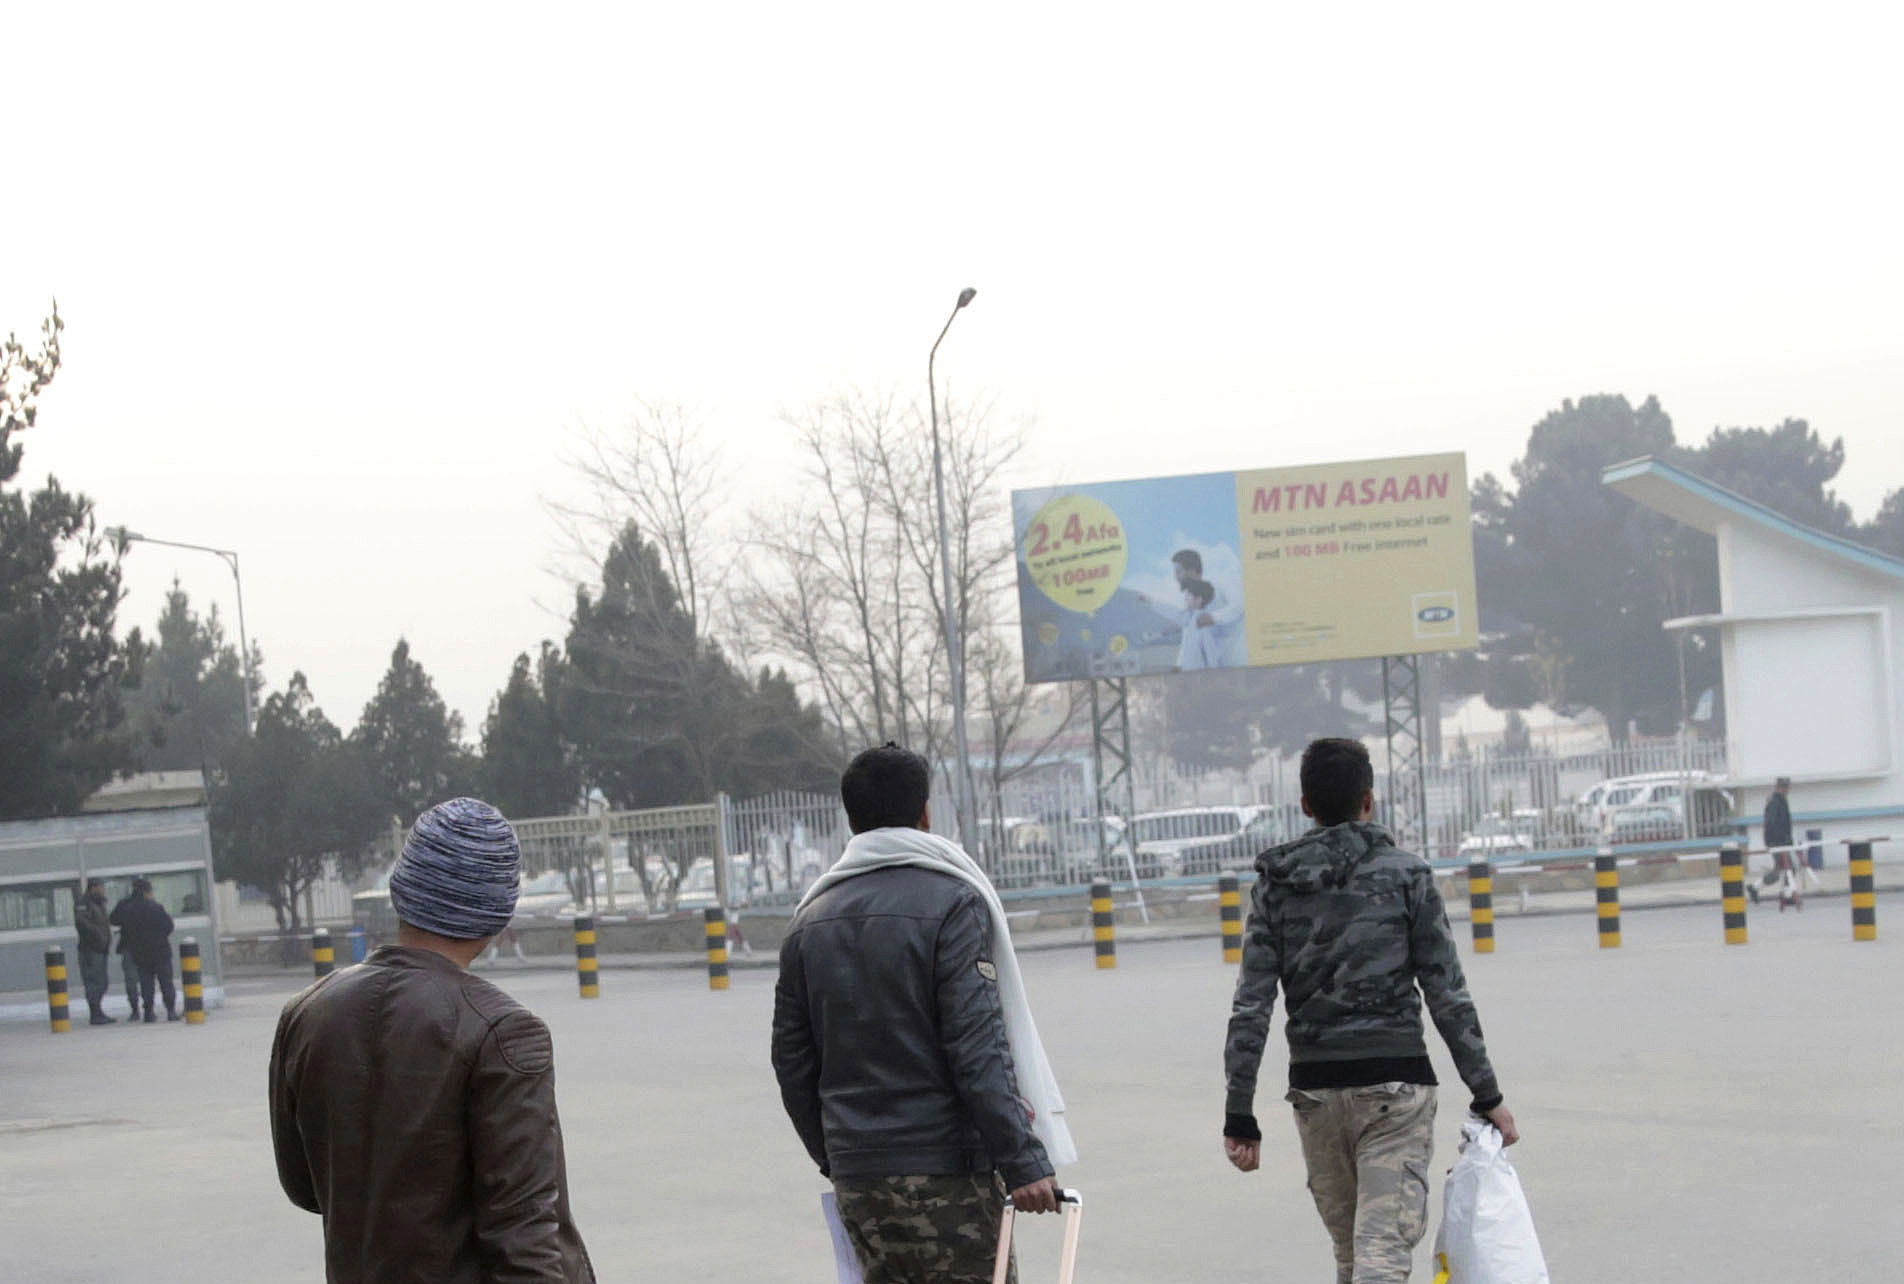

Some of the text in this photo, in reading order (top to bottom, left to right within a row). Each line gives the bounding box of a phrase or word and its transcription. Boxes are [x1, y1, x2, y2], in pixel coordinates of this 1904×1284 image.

[1253, 472, 1449, 514] MTN ASAAN
[1028, 513, 1083, 557] 2.4
[1309, 522, 1336, 533] card
[1338, 518, 1367, 530] with
[1395, 515, 1425, 528] local
[1256, 547, 1280, 560] and
[1284, 544, 1312, 557] 100
[1315, 540, 1340, 555] MB
